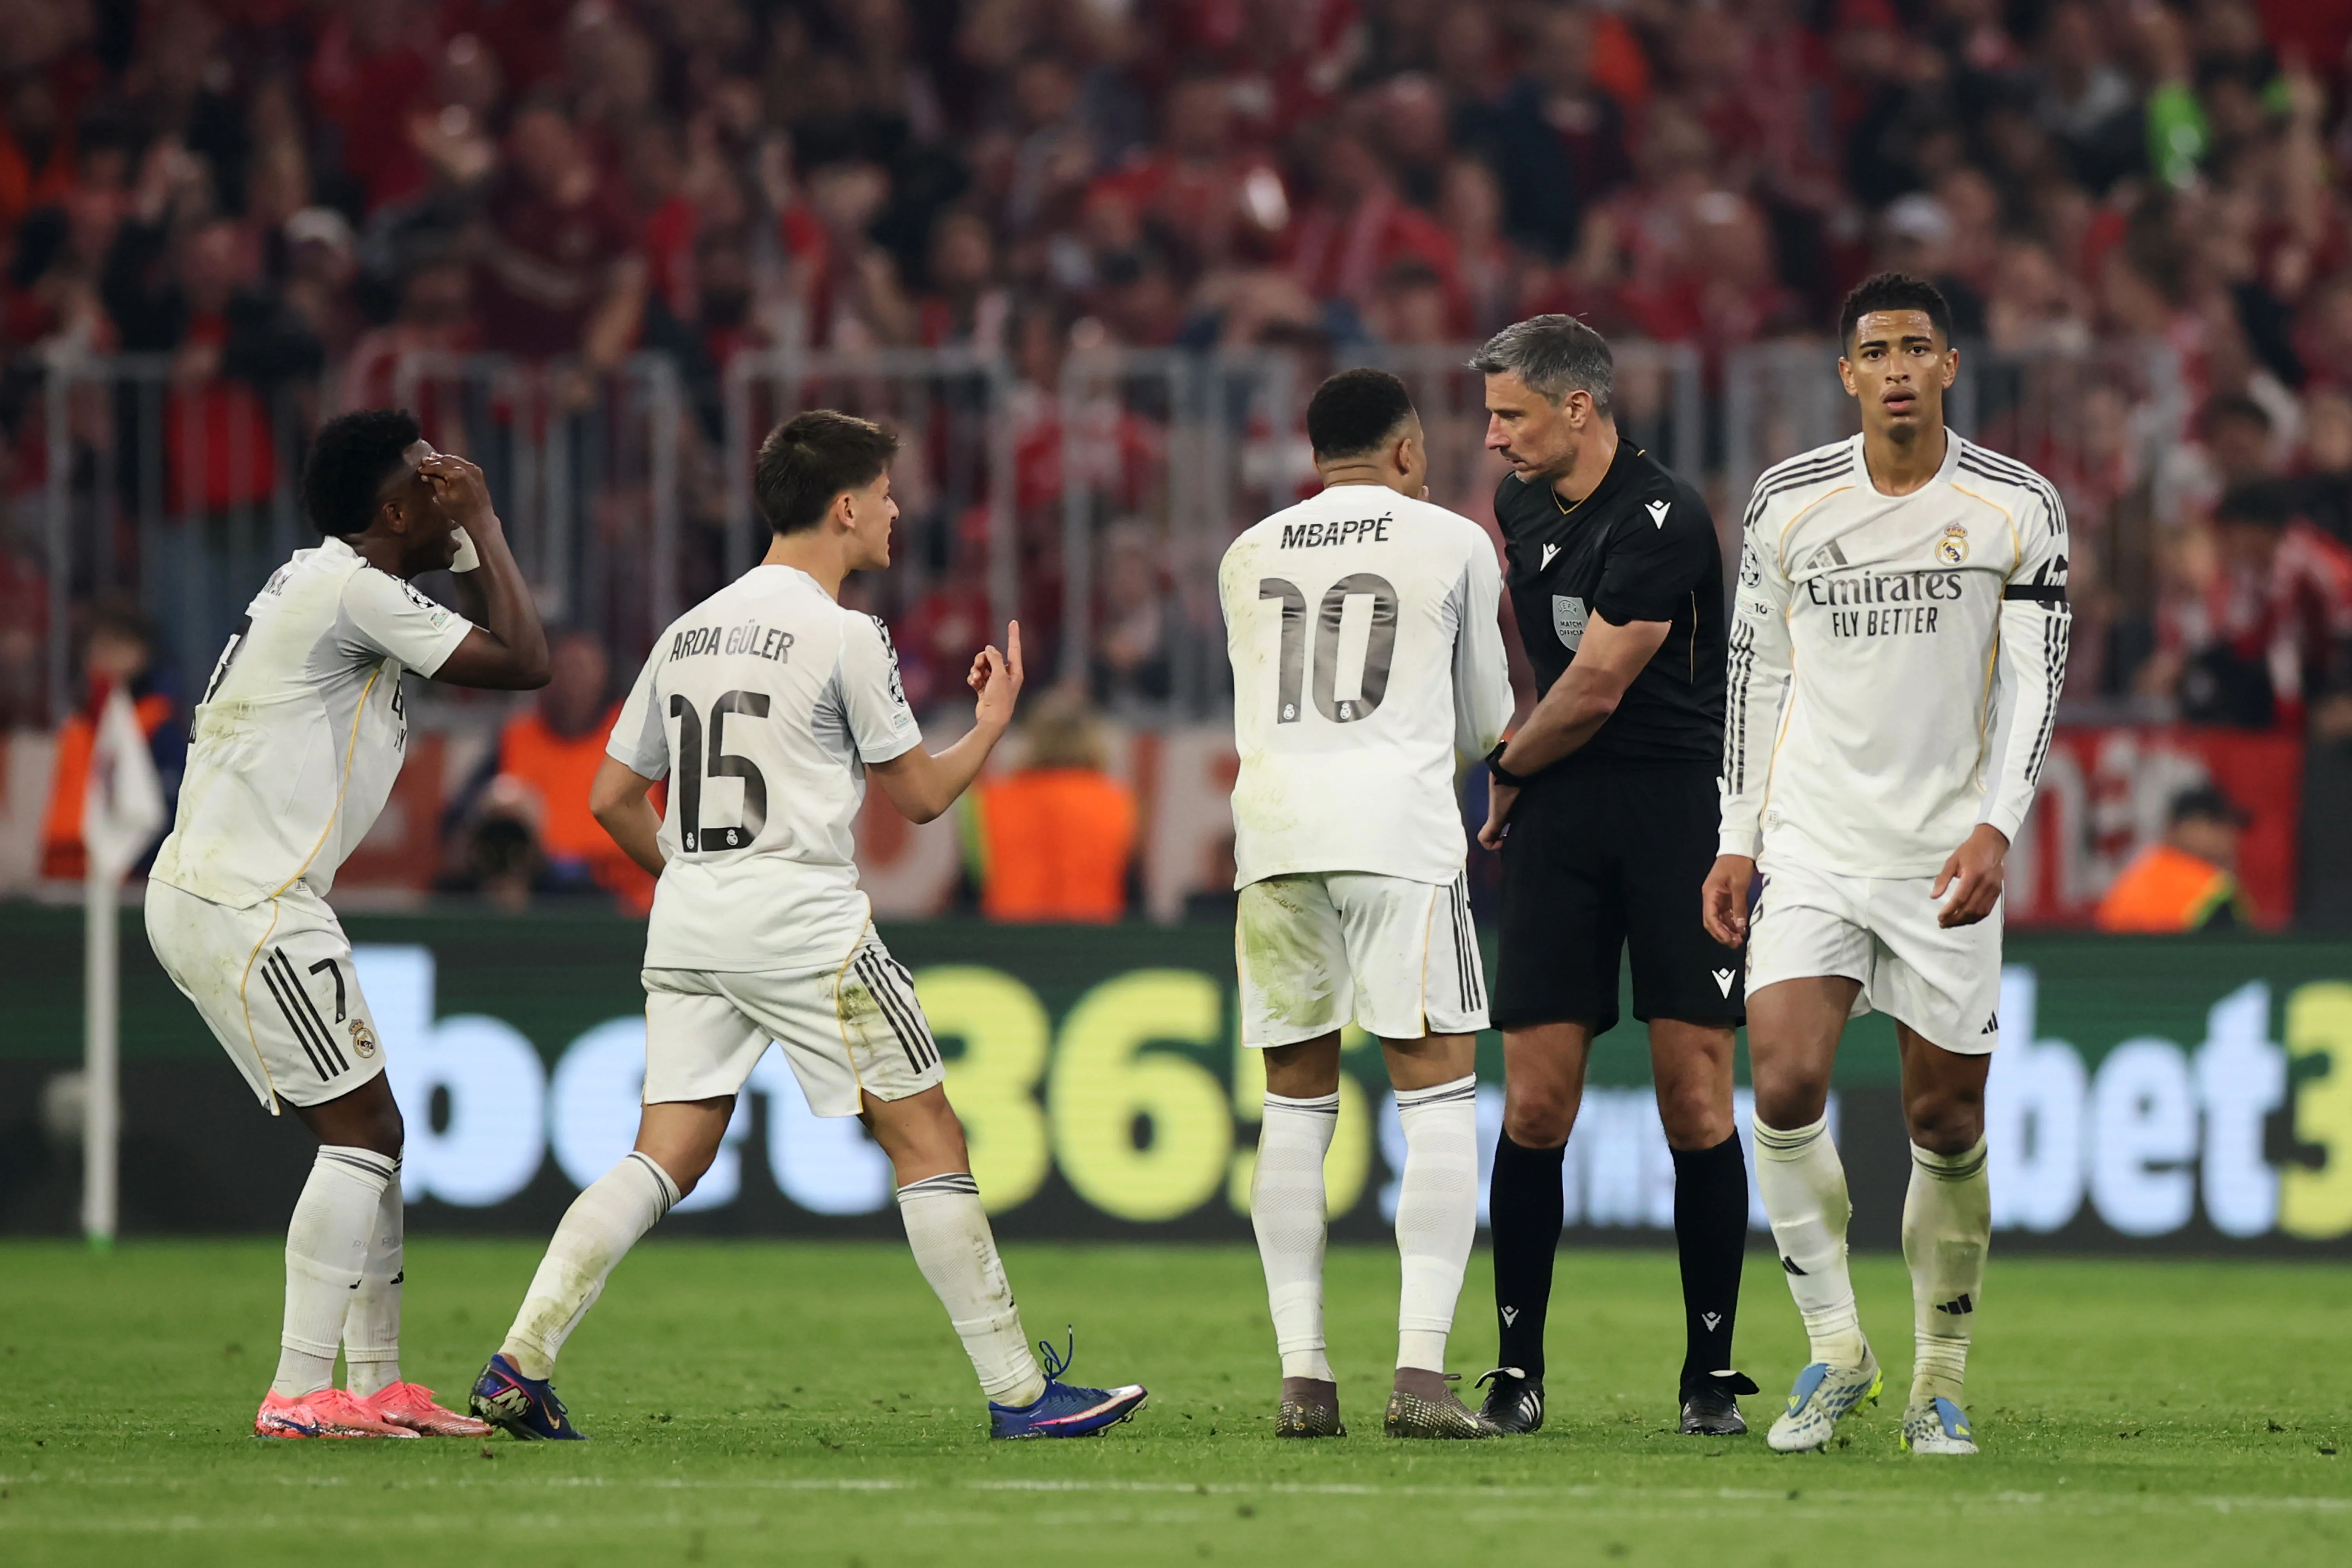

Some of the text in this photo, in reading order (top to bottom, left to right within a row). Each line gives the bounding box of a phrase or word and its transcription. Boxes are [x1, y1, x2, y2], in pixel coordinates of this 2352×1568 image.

[1280, 511, 1393, 549] MBAPPÉ
[1808, 571, 1962, 606] Emirates
[669, 619, 795, 664] ARDA GÜLER
[1833, 607, 1938, 637] FLY BETTER
[1259, 573, 1398, 724] 10
[670, 690, 770, 853] 15
[308, 958, 346, 1024] 7
